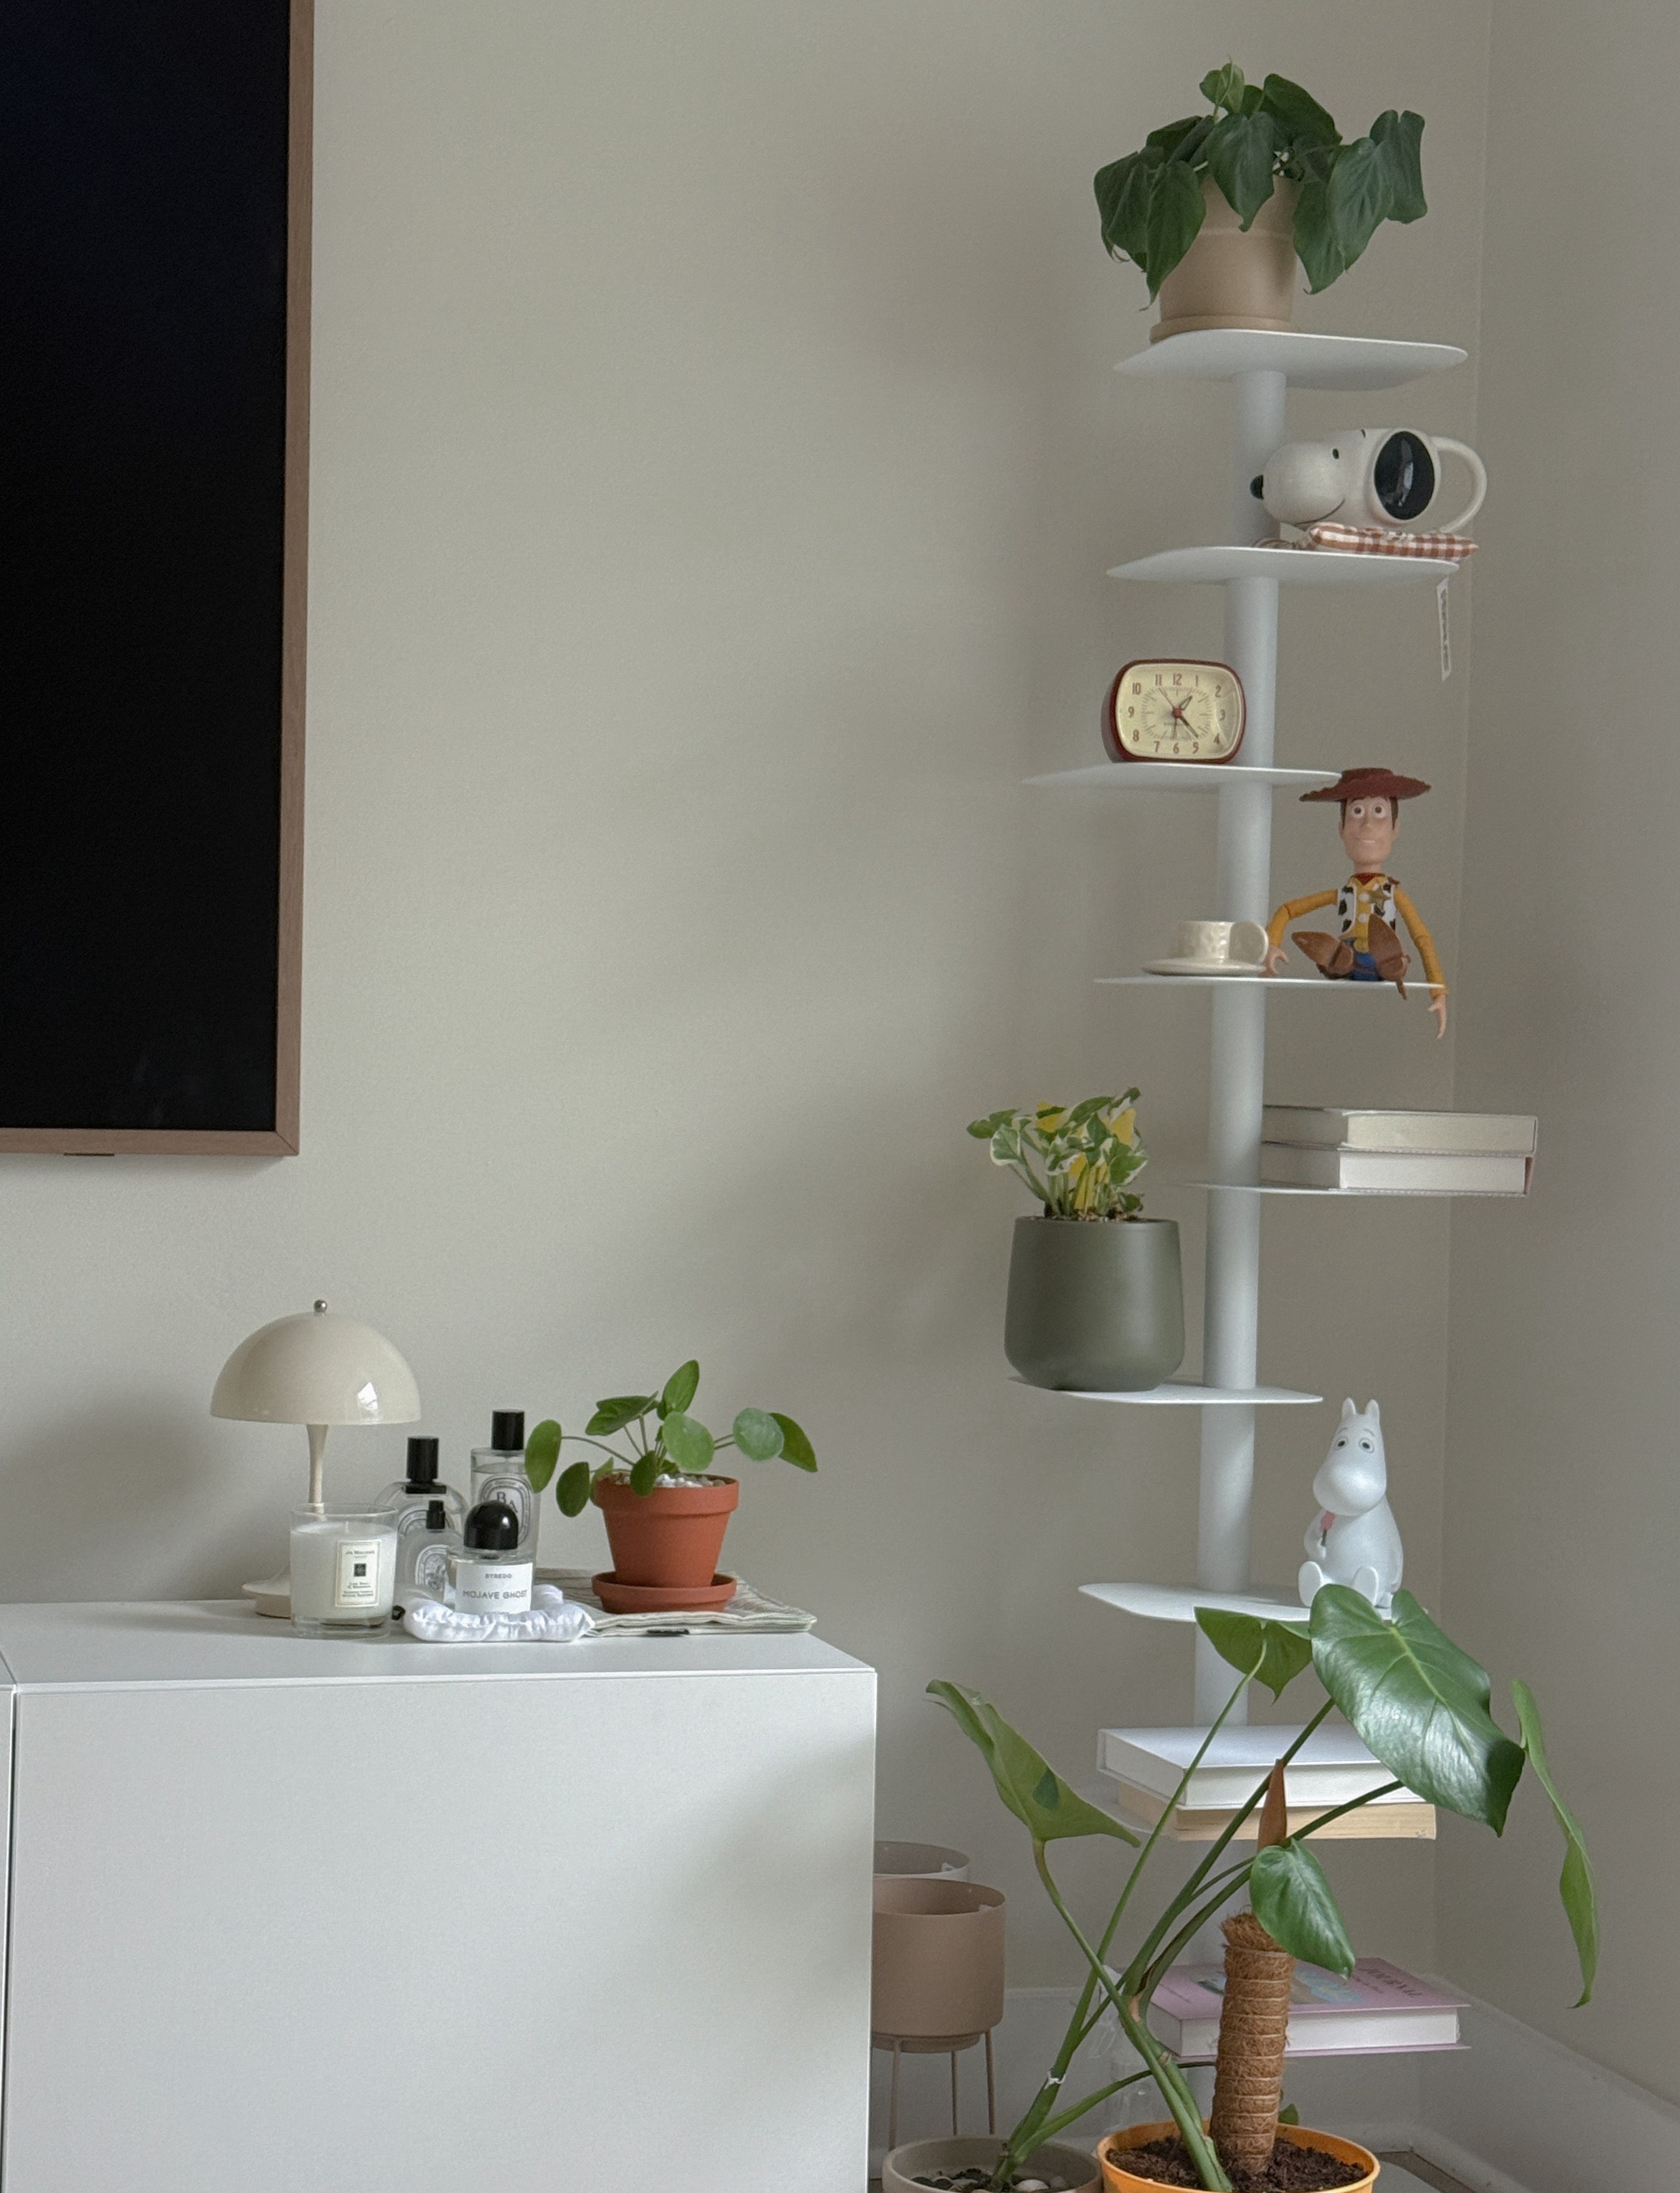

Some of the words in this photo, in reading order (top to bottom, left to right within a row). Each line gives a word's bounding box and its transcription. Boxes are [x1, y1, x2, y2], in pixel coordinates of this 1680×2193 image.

[1155, 674, 1162, 686] 11
[1173, 673, 1183, 685] 12
[1195, 674, 1199, 687] 1
[1132, 683, 1141, 695] 10
[1215, 685, 1221, 698] 2
[1128, 706, 1134, 718] 9
[1219, 709, 1226, 721] 3
[1133, 730, 1140, 742] 8
[1213, 733, 1221, 745] 4
[1154, 741, 1160, 754] 7
[1173, 742, 1179, 754] 6
[1192, 742, 1199, 754] 5
[463, 1590, 499, 1600] MOJAVE
[503, 1590, 528, 1599] GHOST
